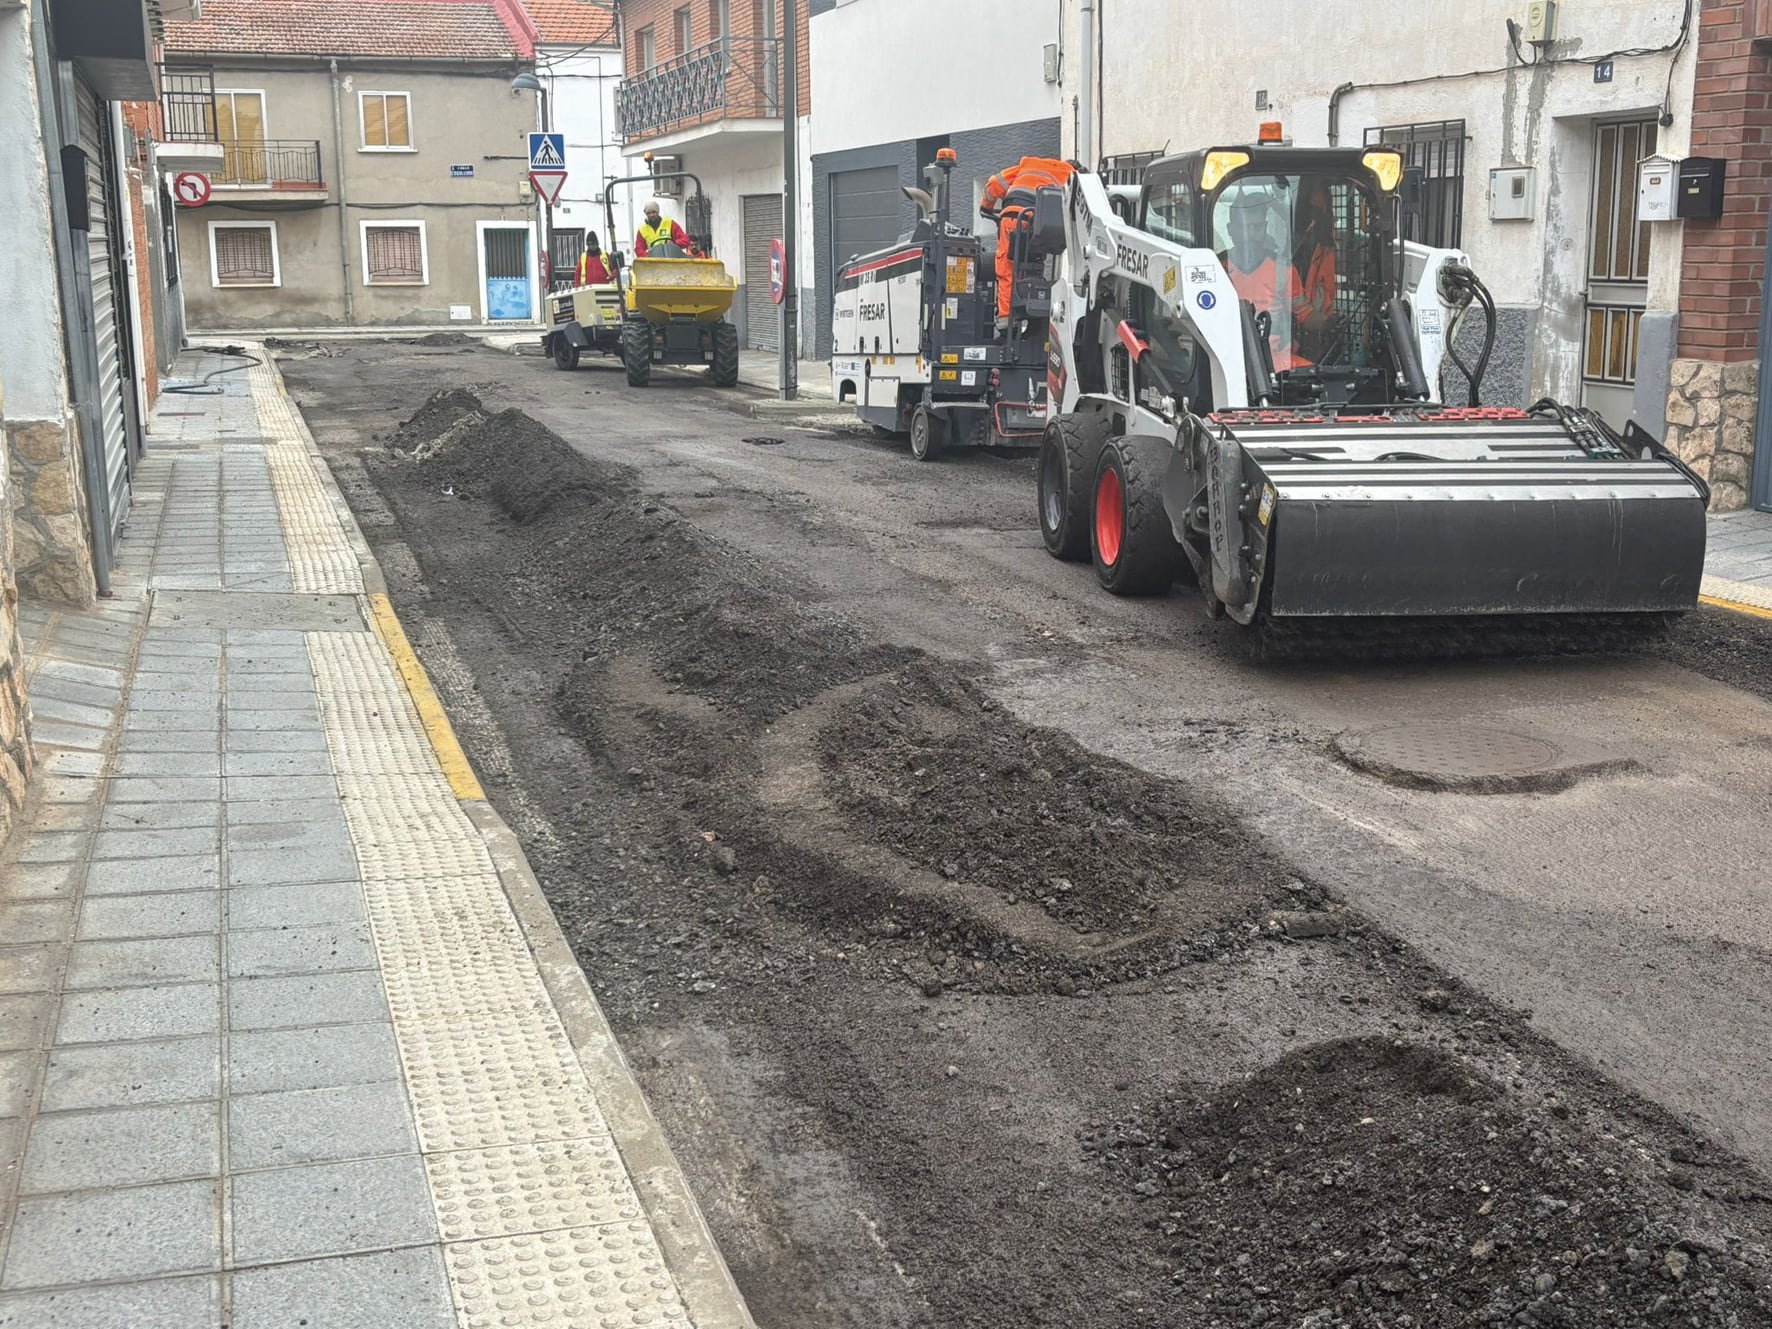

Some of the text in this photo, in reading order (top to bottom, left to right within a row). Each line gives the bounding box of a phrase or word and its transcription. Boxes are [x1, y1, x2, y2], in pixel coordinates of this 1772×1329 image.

[1597, 65, 1611, 79] 14
[1116, 243, 1149, 280] FRESAR
[860, 303, 885, 321] FRESAR
[834, 339, 839, 352] 2
